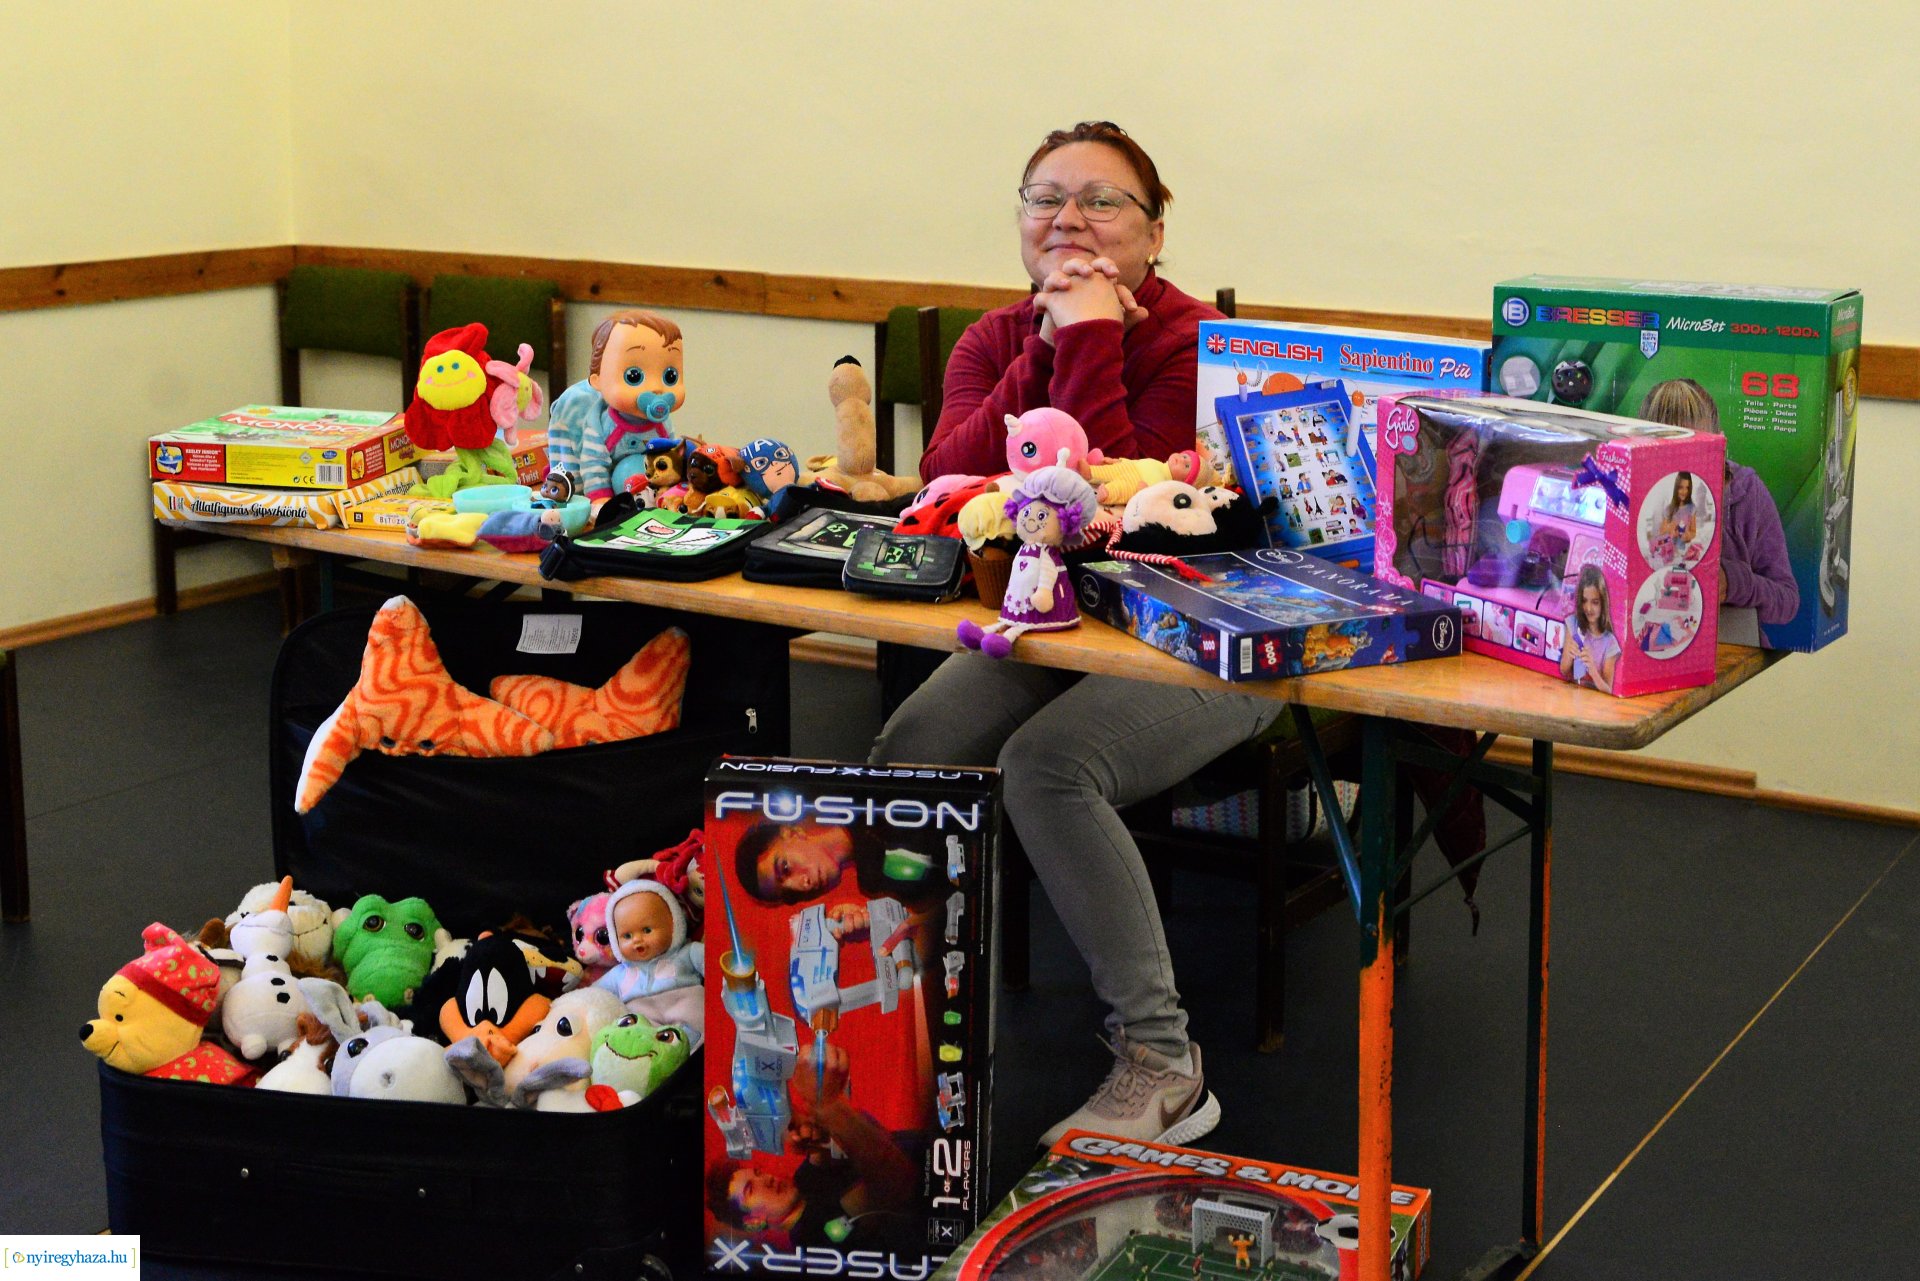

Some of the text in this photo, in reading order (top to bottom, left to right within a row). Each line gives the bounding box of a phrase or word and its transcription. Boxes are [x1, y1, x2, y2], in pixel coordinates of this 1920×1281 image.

[1536, 305, 1660, 328] BRESSER
[1666, 316, 1726, 333] MicroSet
[1730, 322, 1768, 336] 300x
[1775, 326, 1821, 339] 1200x
[1229, 338, 1323, 363] ENGLISH
[1339, 343, 1434, 375] Sapientino
[1742, 371, 1800, 399] 68
[1384, 407, 1415, 449] Girls
[1297, 563, 1414, 606] PANORAMA
[1202, 640, 1216, 651] 1000
[1264, 640, 1277, 665] 1000
[719, 761, 984, 782] LASER X FUSION
[715, 791, 980, 832] FUSION
[932, 1138, 962, 1209] 1 or 2
[962, 1140, 972, 1211] PLAYERS
[1069, 1136, 1232, 1177] GAMES
[1236, 1165, 1272, 1183] &
[713, 1237, 751, 1273] X
